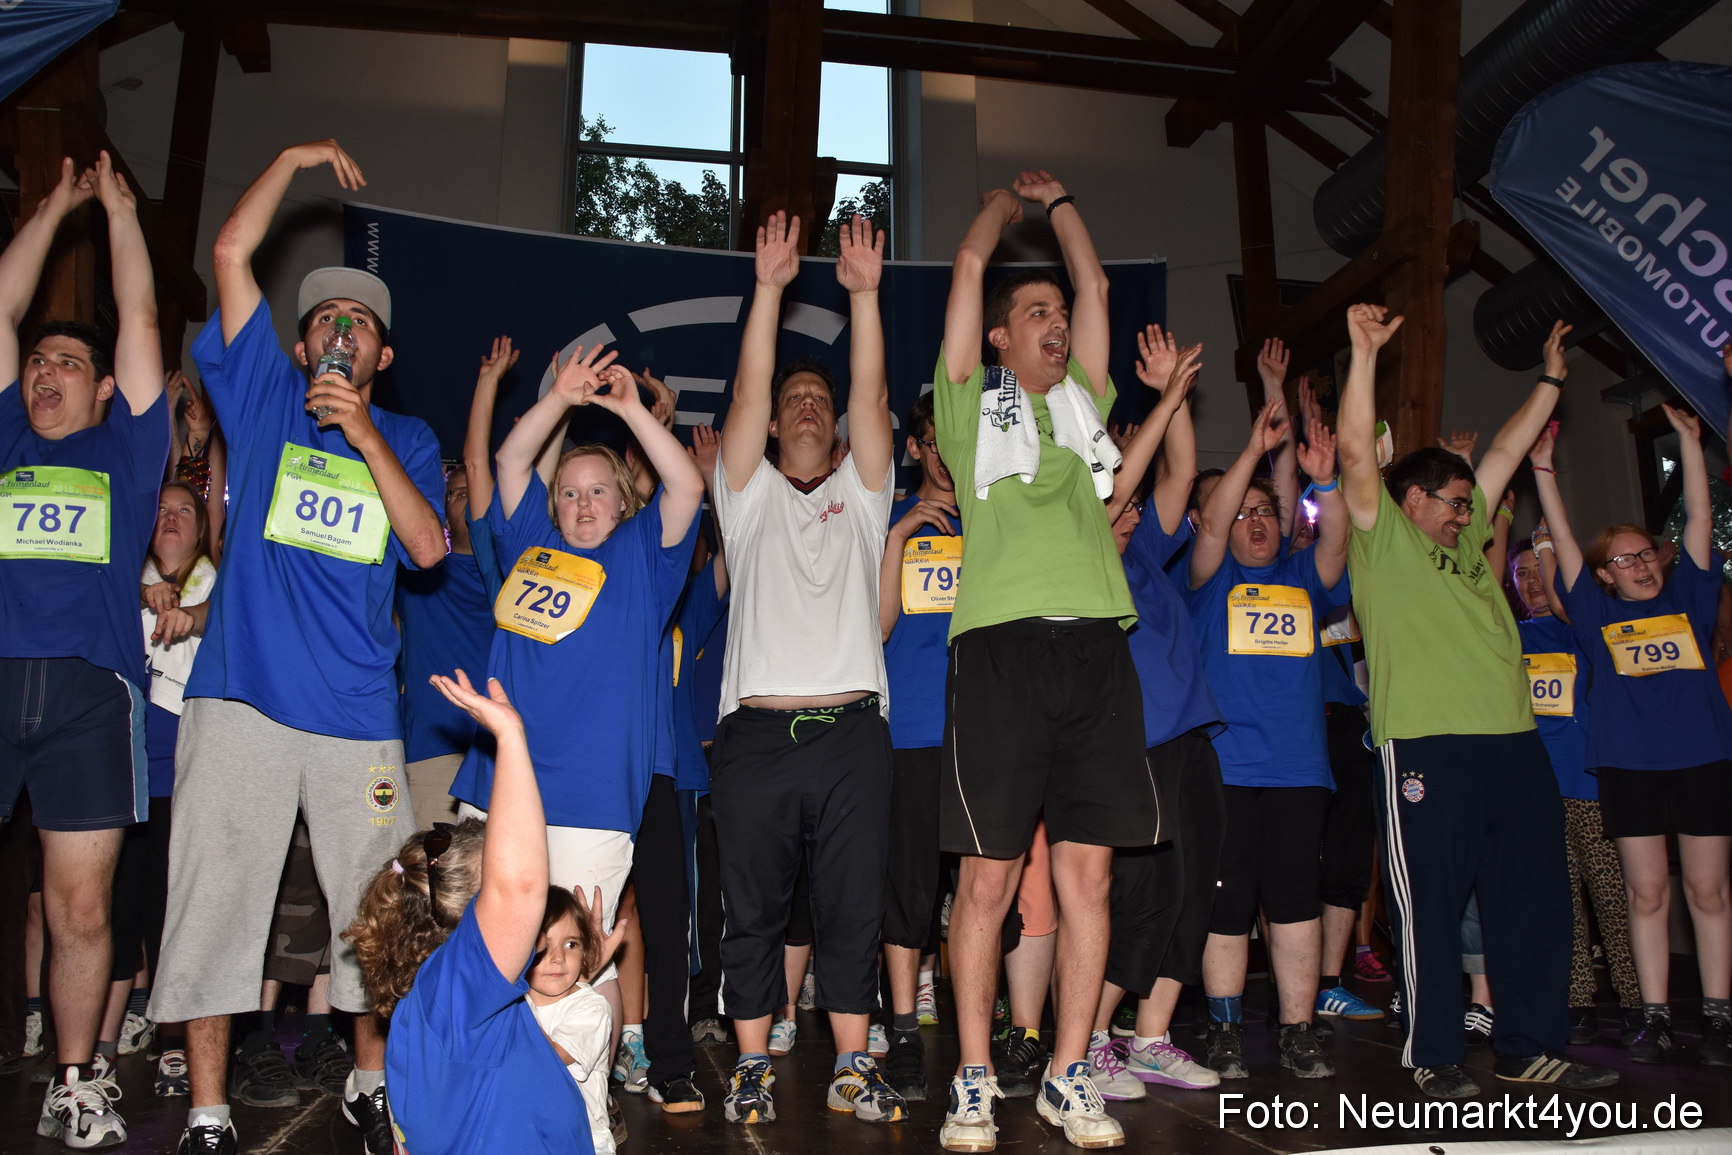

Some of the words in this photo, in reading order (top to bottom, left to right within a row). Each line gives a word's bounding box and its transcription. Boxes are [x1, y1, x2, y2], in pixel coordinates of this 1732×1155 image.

[12, 502, 87, 534] 787
[295, 489, 365, 534] 801
[46, 538, 83, 547] Wodianka
[300, 527, 327, 540] Samuel
[327, 534, 352, 546] Bagam
[918, 566, 962, 592] 79
[514, 579, 571, 619] 729
[513, 612, 531, 623] Carina
[530, 618, 551, 630] Spitzer
[1245, 611, 1297, 637] 728
[1625, 640, 1681, 665] 799
[1529, 678, 1563, 700] 60
[369, 816, 397, 827] 1907
